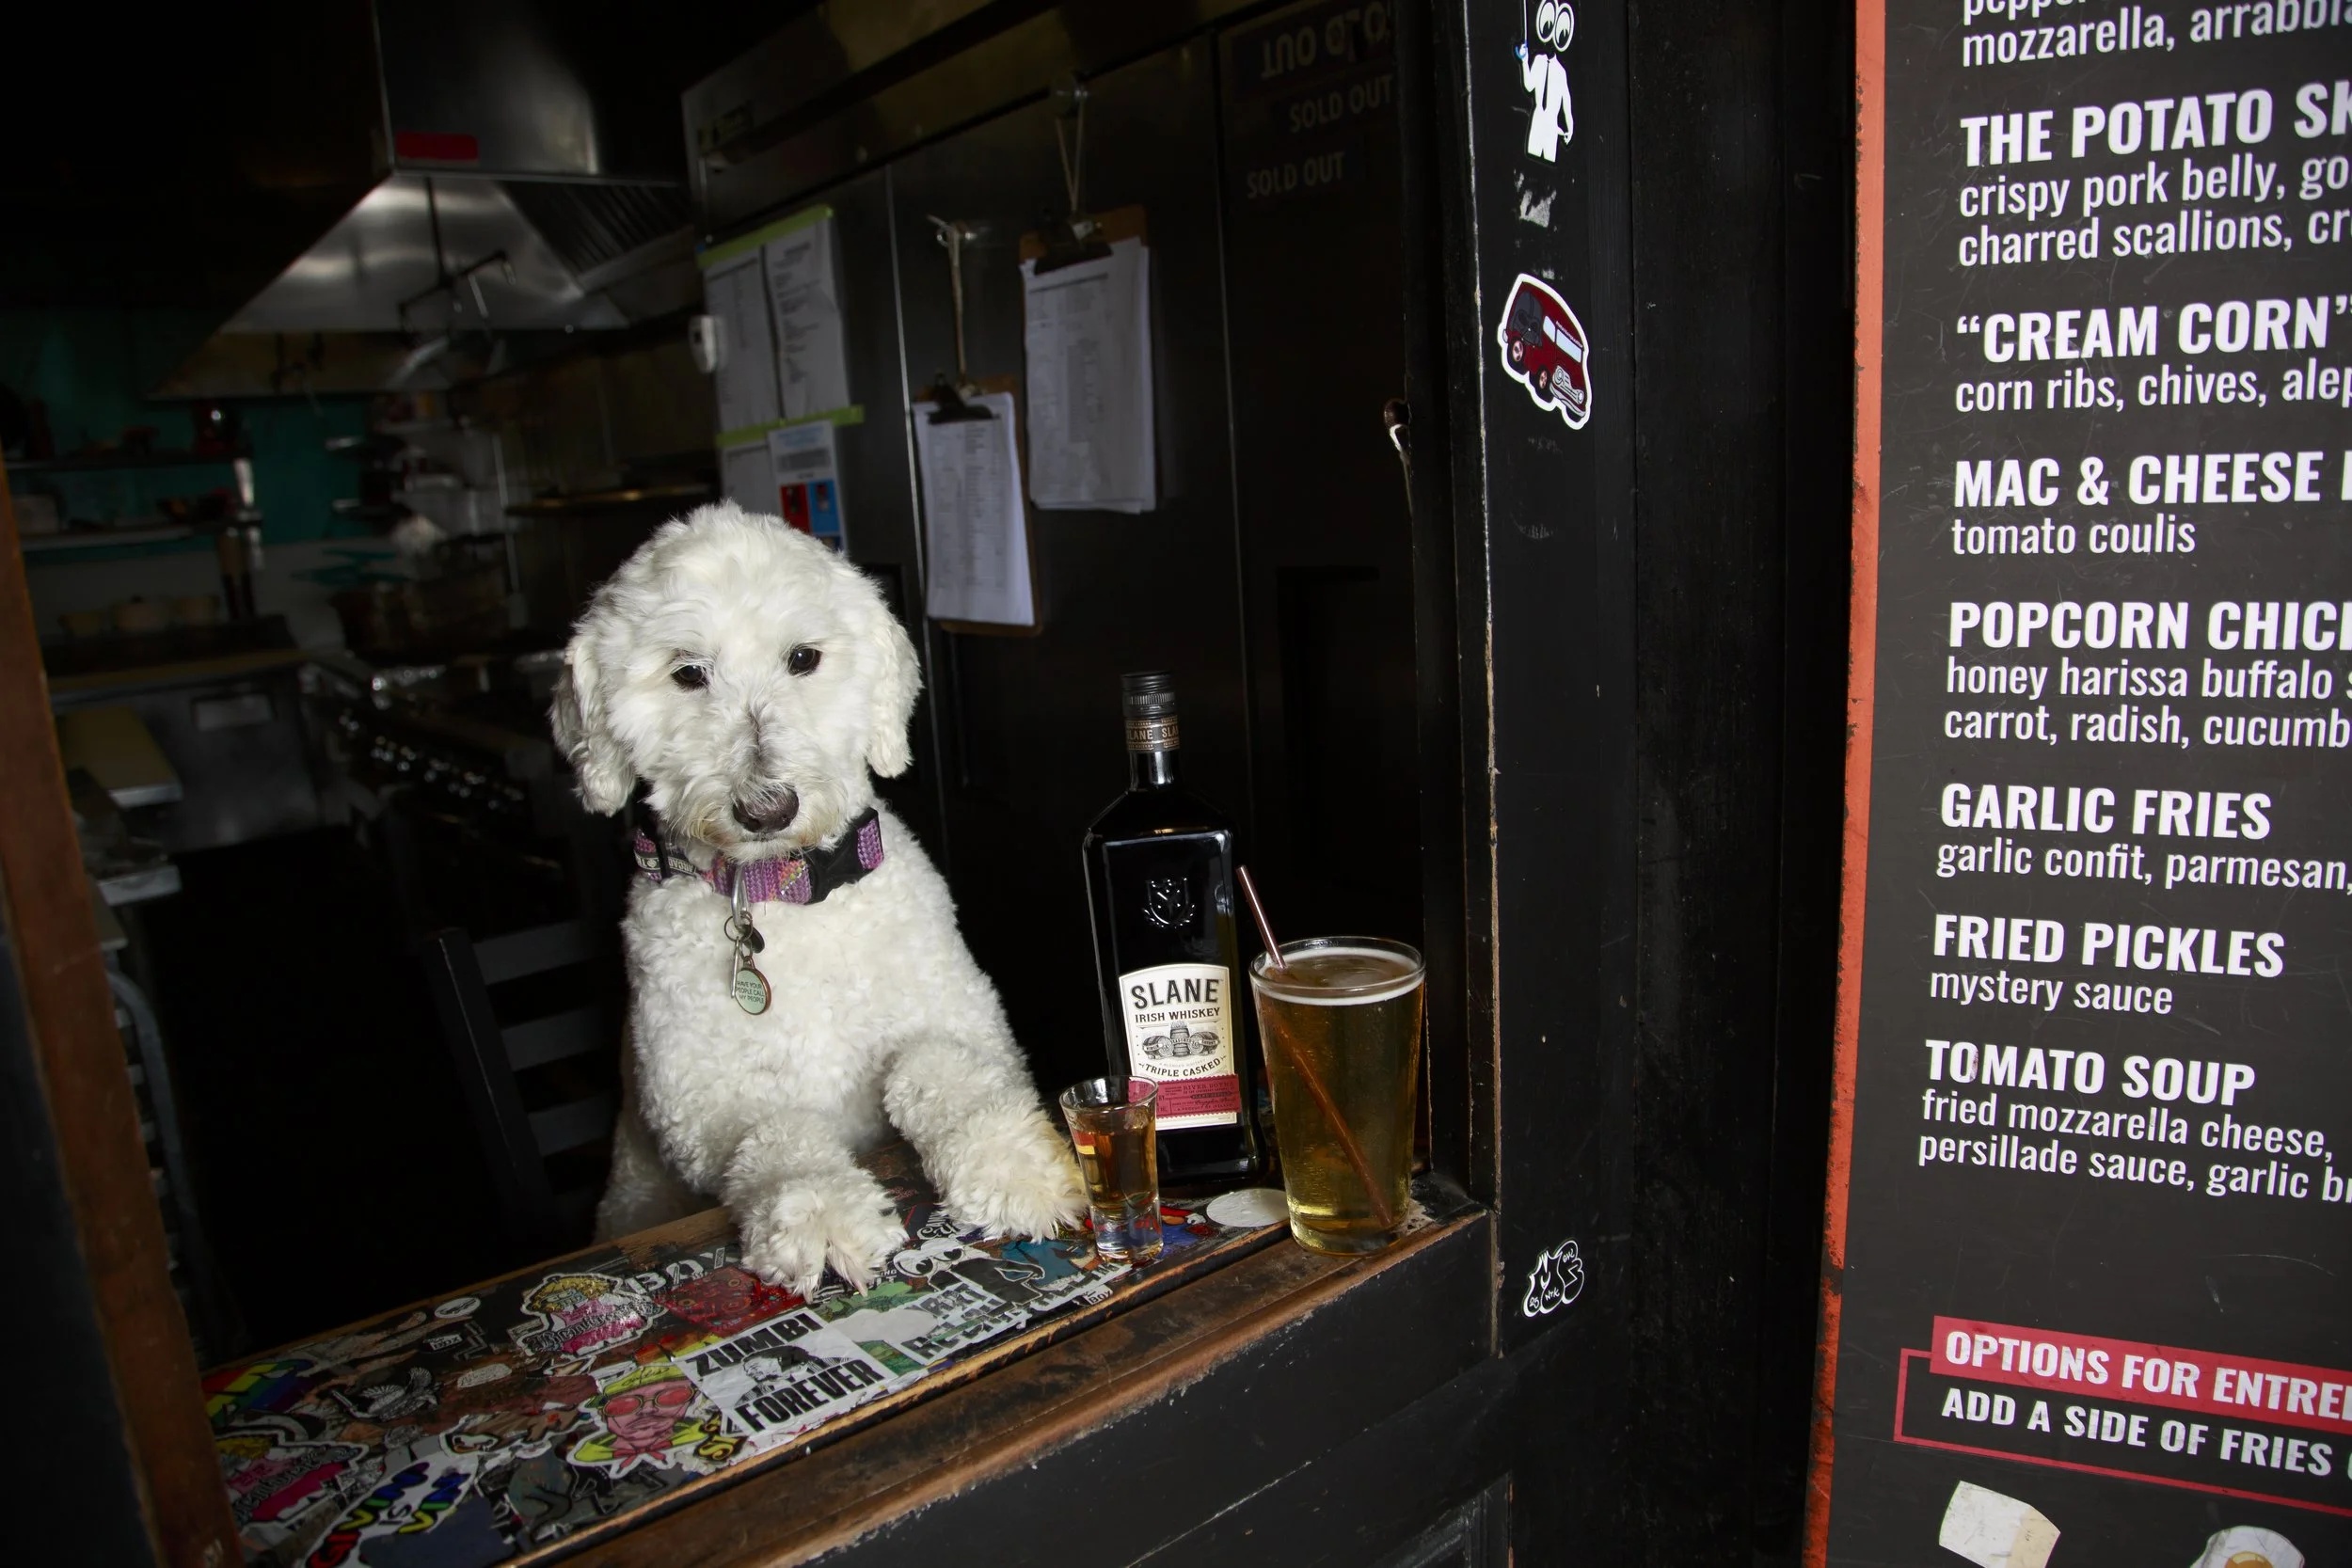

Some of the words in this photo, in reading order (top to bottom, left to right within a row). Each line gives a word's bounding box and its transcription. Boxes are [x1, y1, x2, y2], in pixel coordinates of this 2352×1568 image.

[1963, 4, 2175, 68] mozzarella,
[1289, 90, 1343, 134] SOLD
[1349, 73, 1392, 114] OUT
[1960, 110, 2054, 167] THE
[2072, 89, 2273, 158] POTATO
[1247, 163, 1297, 199] SOLD
[1303, 150, 1345, 186] OUT
[1960, 174, 2071, 222] crispy
[2083, 161, 2169, 218] pork
[2182, 152, 2285, 203] belly,
[1959, 216, 2099, 267] charred
[2112, 209, 2292, 258] scallions,
[2308, 209, 2352, 245] cr
[1957, 305, 2157, 363] “CREAM
[1956, 380, 2033, 413] corn
[2046, 367, 2124, 413] ribs,
[2137, 363, 2266, 408] chives,
[1954, 457, 2060, 508] MAC
[2076, 456, 2109, 506] &
[2128, 451, 2324, 505] CHEESE
[1951, 517, 2076, 555] tomato
[2089, 512, 2196, 554] coulis
[1949, 601, 2189, 650] POPCORN
[1947, 655, 2048, 701] honey
[2060, 656, 2188, 697] harissa
[2201, 657, 2332, 700] buffalo
[1127, 728, 1153, 740] LANE
[1945, 705, 2058, 746] carrot,
[2071, 704, 2189, 750] radish,
[2203, 707, 2351, 749] cucumb
[1941, 783, 2116, 833] GARLIC
[2132, 789, 2271, 840] FRIES
[1936, 836, 2032, 879] garlic
[2044, 843, 2153, 886] confit,
[1933, 913, 2065, 963] FRIED
[2081, 922, 2284, 978] PICKLES
[747, 995, 764, 1004] PEOPLE
[1131, 978, 1220, 1009] SLANE
[1135, 1011, 1166, 1023] IRISH
[1168, 1006, 1221, 1021] WHISKEY
[1931, 970, 2064, 1012] mystery
[2073, 982, 2173, 1015] sauce
[1145, 1063, 1180, 1077] TRIPLE
[1183, 1057, 1221, 1077] CASKED
[1925, 1038, 2106, 1097] TOMATO
[2122, 1055, 2255, 1106] SOUP
[1922, 1088, 1997, 1127] fried
[2008, 1103, 2188, 1145] mozzarella
[2201, 1113, 2332, 1164] cheese,
[1918, 1134, 2077, 1175] persillade
[2088, 1152, 2195, 1192] sauce,
[2205, 1160, 2309, 1198] garlic
[687, 1313, 823, 1378] ZUMBI
[1946, 1330, 2110, 1385] OPTIONS
[2122, 1354, 2201, 1399] FOR
[735, 1359, 886, 1432] FOREVER
[1941, 1387, 2016, 1426] ADD
[2026, 1400, 2051, 1433] A
[2063, 1405, 2149, 1448] SIDE
[2160, 1419, 2209, 1455] OF
[2219, 1428, 2333, 1477] FRIES
